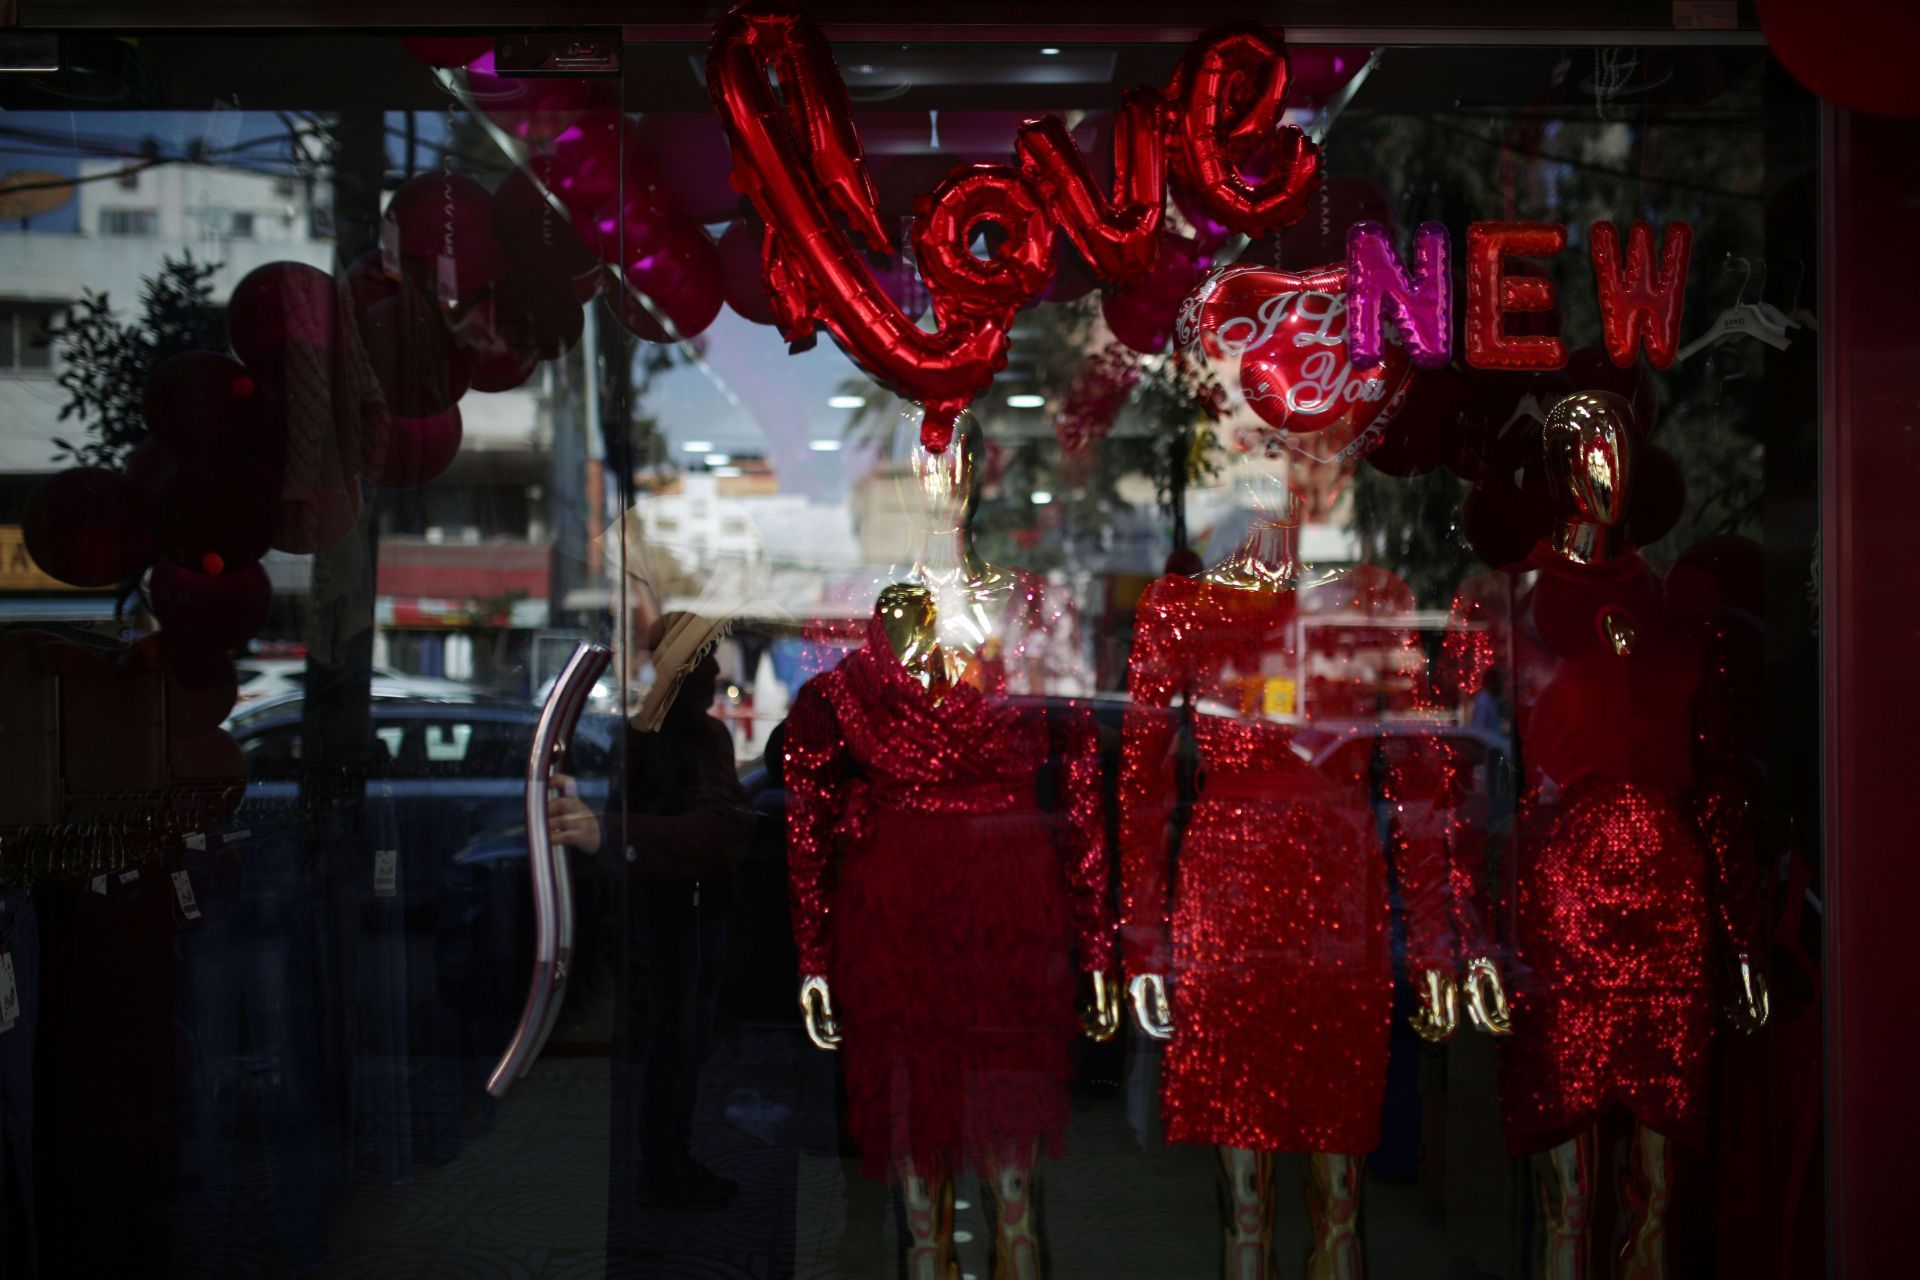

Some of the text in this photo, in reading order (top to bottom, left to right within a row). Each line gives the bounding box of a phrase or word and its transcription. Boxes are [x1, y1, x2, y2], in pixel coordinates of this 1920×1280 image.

[1217, 291, 1300, 355] I
[1346, 220, 1693, 371] NEW
[1286, 351, 1387, 415] You
